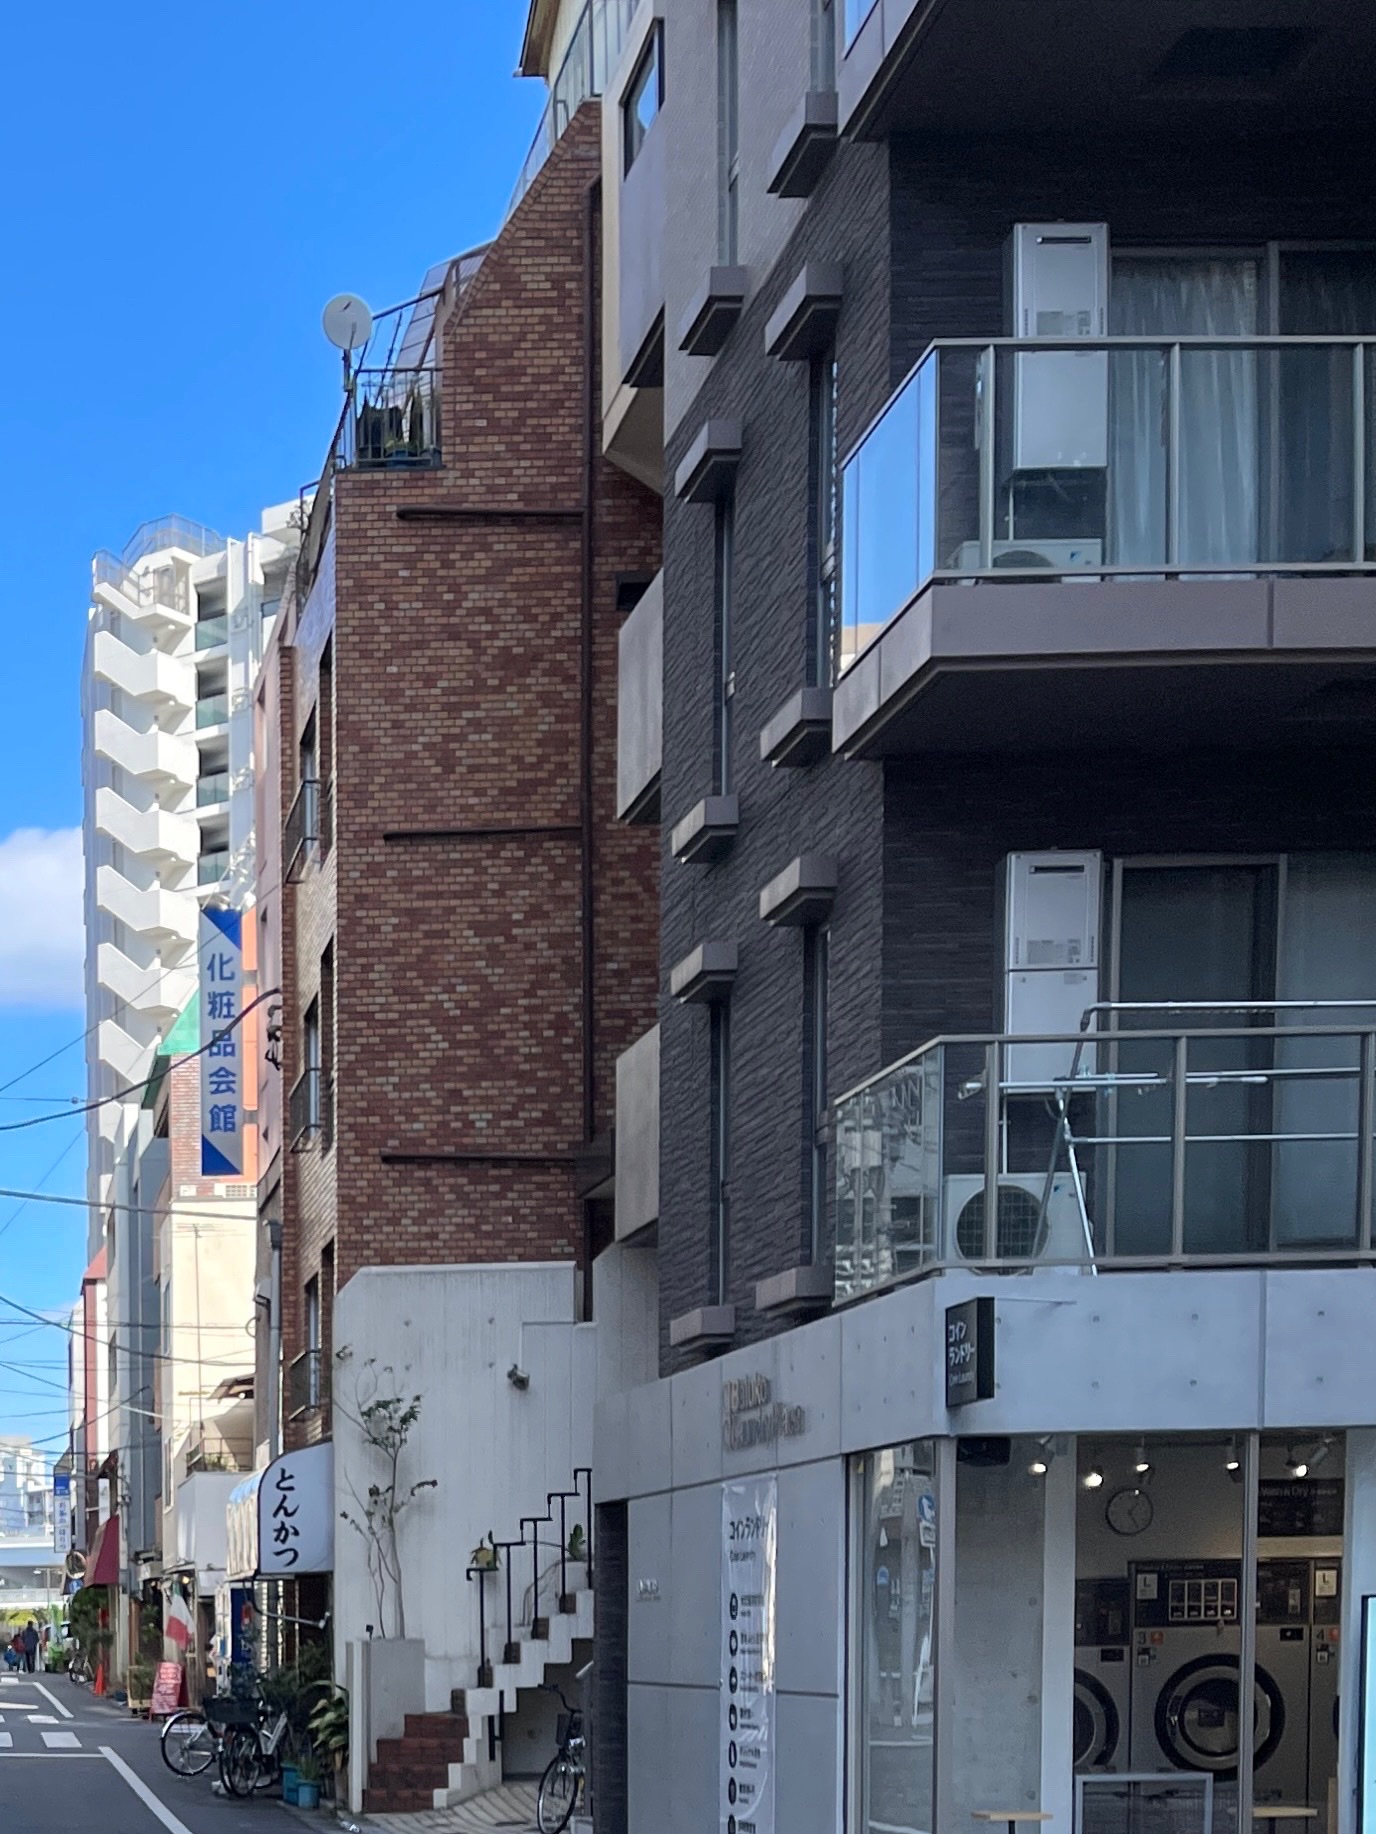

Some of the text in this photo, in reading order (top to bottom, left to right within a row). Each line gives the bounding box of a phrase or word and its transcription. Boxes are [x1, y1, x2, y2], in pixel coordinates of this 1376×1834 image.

[206, 952, 237, 1133] 化粧品会館
[949, 1321, 967, 1342] コイン
[949, 1342, 975, 1367] ランドリー
[272, 1467, 300, 1567] とんかつ
